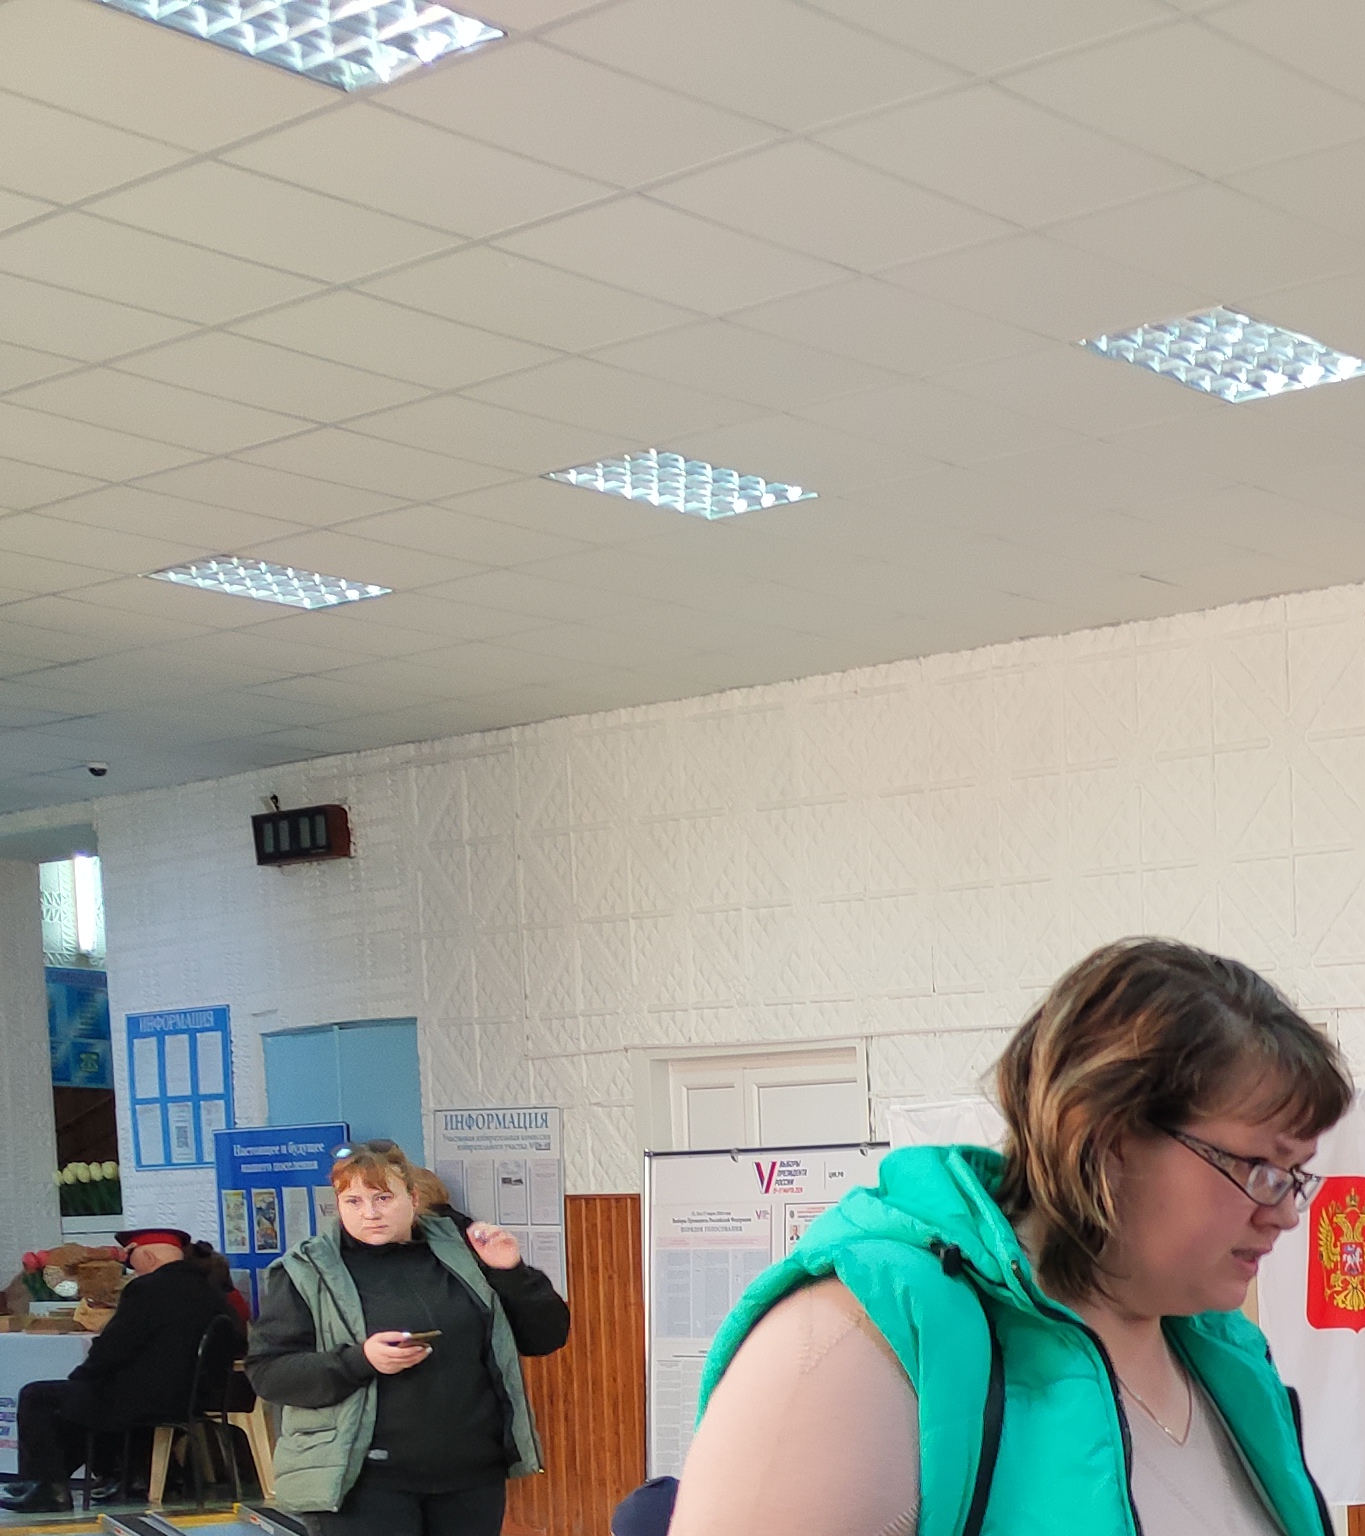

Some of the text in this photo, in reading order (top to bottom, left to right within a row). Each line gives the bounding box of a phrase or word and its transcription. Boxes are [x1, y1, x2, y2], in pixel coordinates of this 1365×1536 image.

[139, 1011, 214, 1032] ИНФОРМАЦИЯ
[443, 1112, 549, 1131] ИНФОРМАЦИЯ
[233, 1144, 280, 1157] Настоящее
[288, 1141, 325, 1156] будущее
